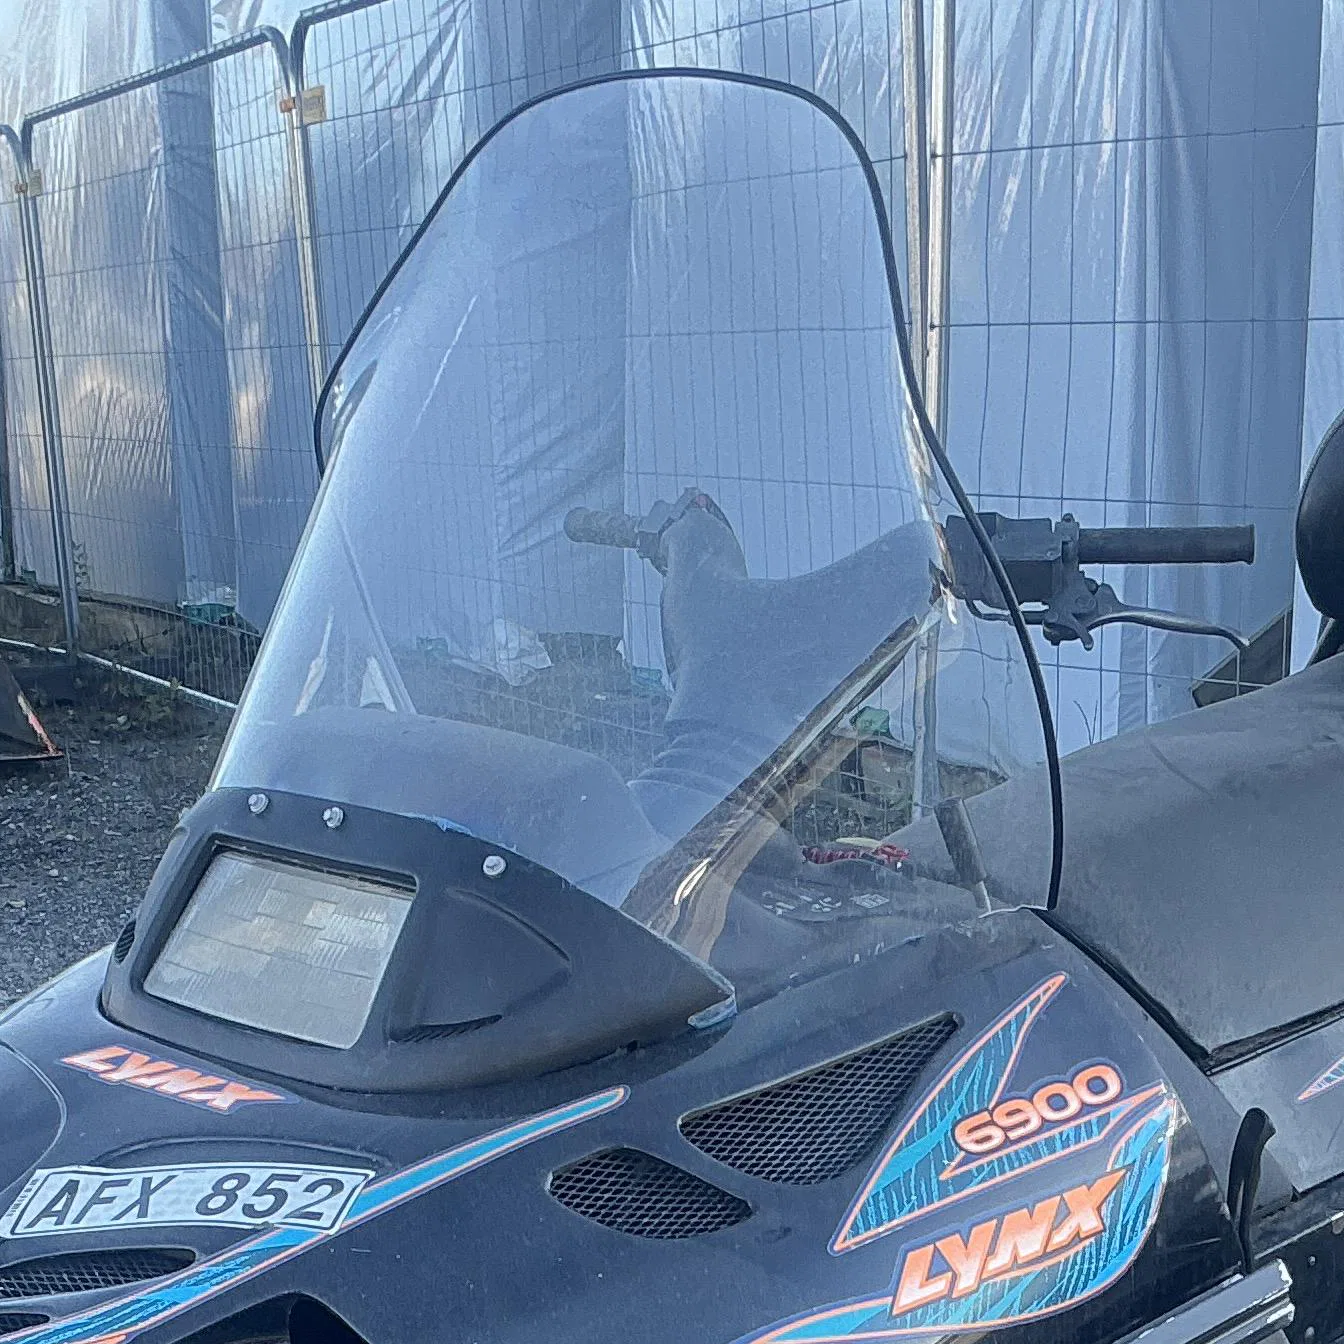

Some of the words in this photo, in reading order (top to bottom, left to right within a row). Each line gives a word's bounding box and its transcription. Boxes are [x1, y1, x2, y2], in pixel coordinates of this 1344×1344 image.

[60, 1045, 286, 1111] LYNX
[953, 1064, 1123, 1154] 6900
[24, 1174, 177, 1229] AFX
[194, 1172, 345, 1222] 852
[892, 1168, 1128, 1316] LYNX
